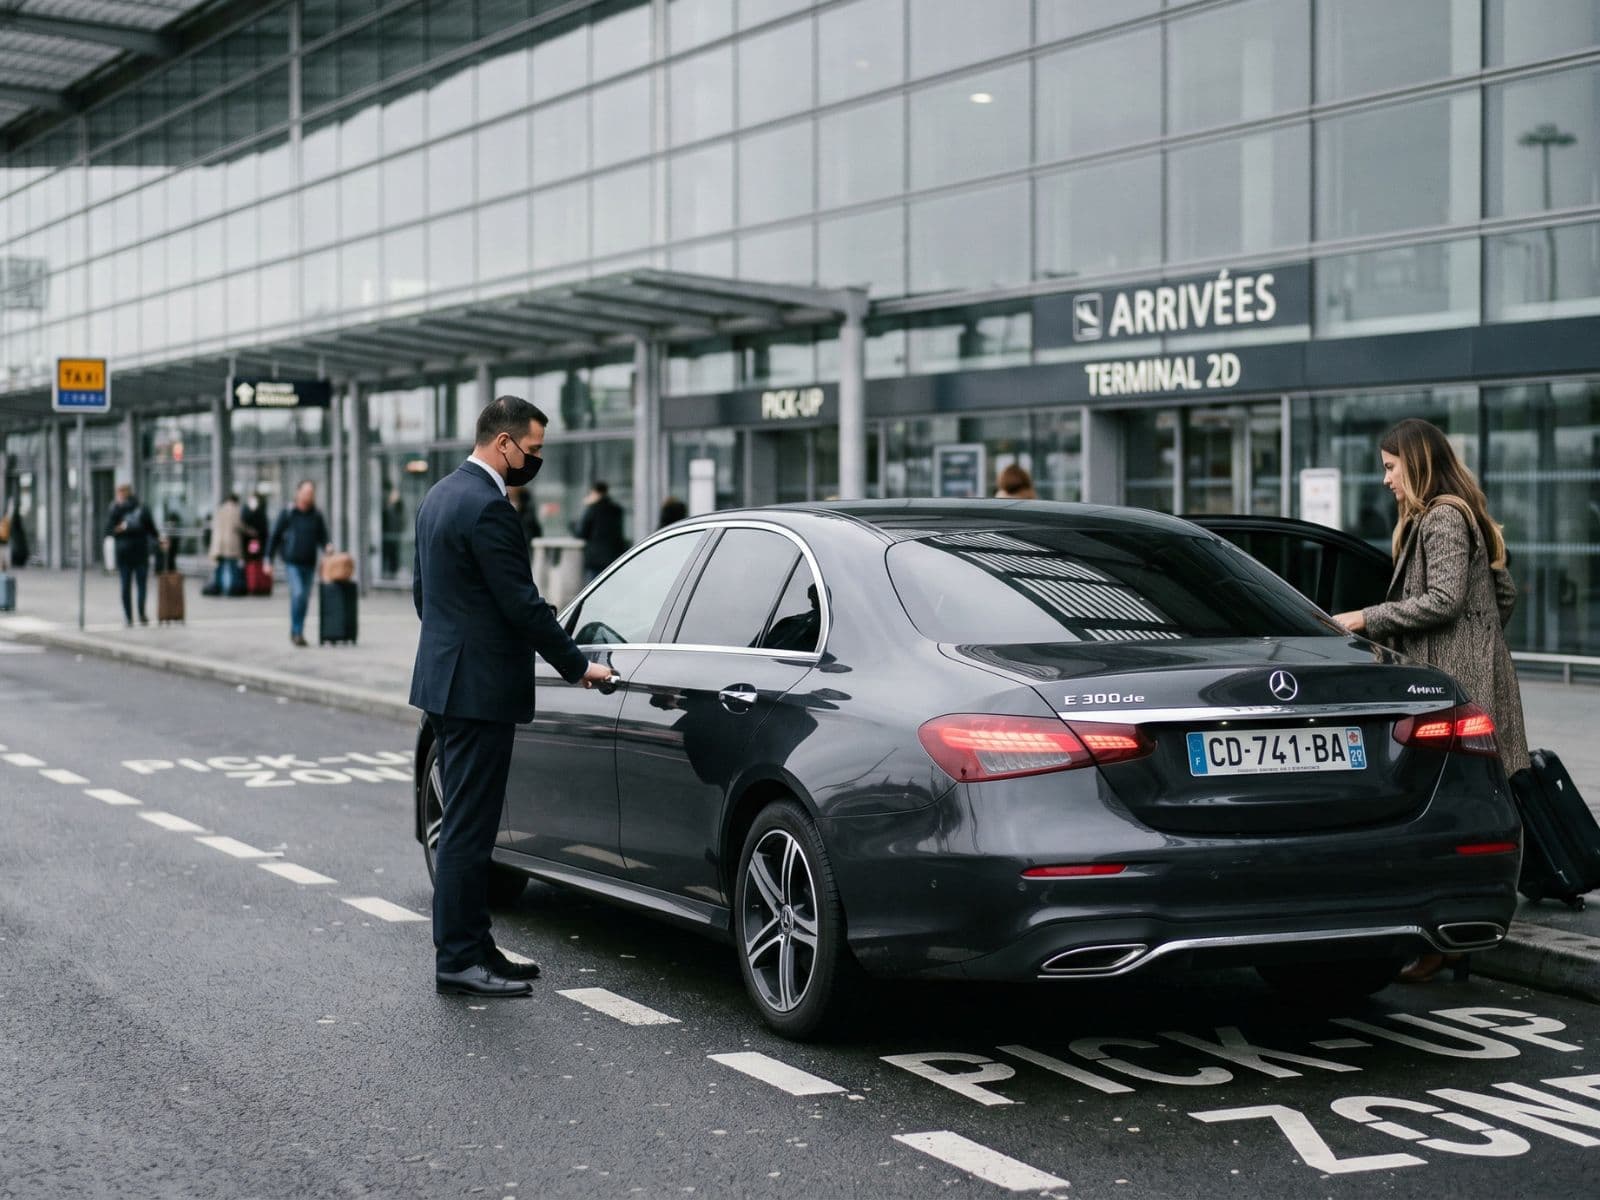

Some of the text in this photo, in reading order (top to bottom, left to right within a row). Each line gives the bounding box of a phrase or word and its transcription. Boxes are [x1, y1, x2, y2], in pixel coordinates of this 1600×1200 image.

[1108, 268, 1277, 337] ARRIVÉES
[1084, 353, 1241, 396] TERMINAL 2D
[761, 387, 824, 420] PICK-UP
[1064, 694, 1077, 705] E
[1195, 757, 1201, 766] F
[1208, 733, 1346, 767] CD-741-BA
[224, 766, 415, 788] ZON
[880, 1006, 1583, 1106] PICK-UP
